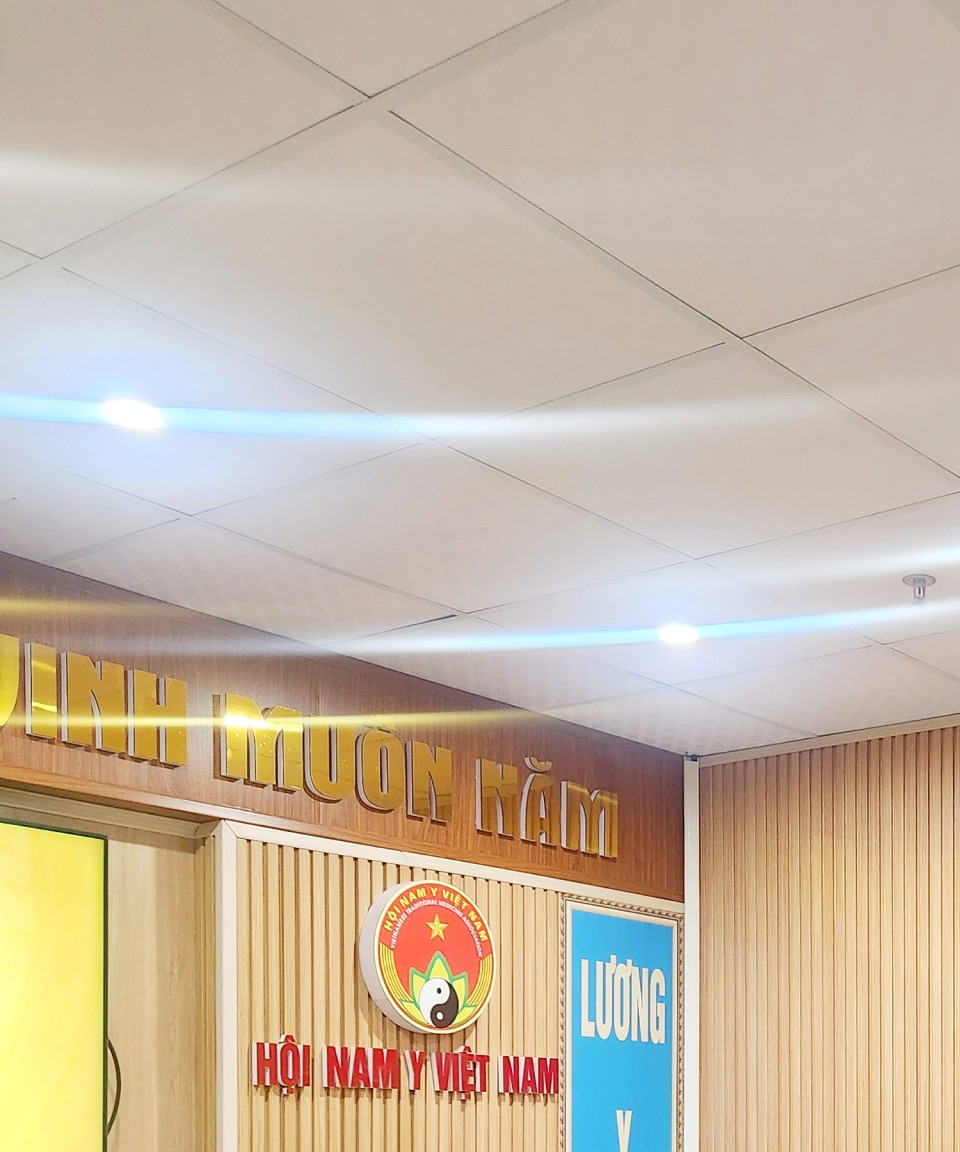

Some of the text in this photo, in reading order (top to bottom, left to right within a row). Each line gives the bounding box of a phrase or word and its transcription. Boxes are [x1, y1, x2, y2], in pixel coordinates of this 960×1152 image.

[220, 690, 453, 823] MUÔN
[475, 755, 618, 858] NĂM
[400, 887, 427, 909] NAM
[430, 887, 438, 897] Y
[442, 889, 469, 910] VIỆT
[468, 911, 489, 942] NAM
[580, 953, 667, 1046] LƯƠNG
[252, 1034, 559, 1100] HỘI NAM Y VIỆT NAM
